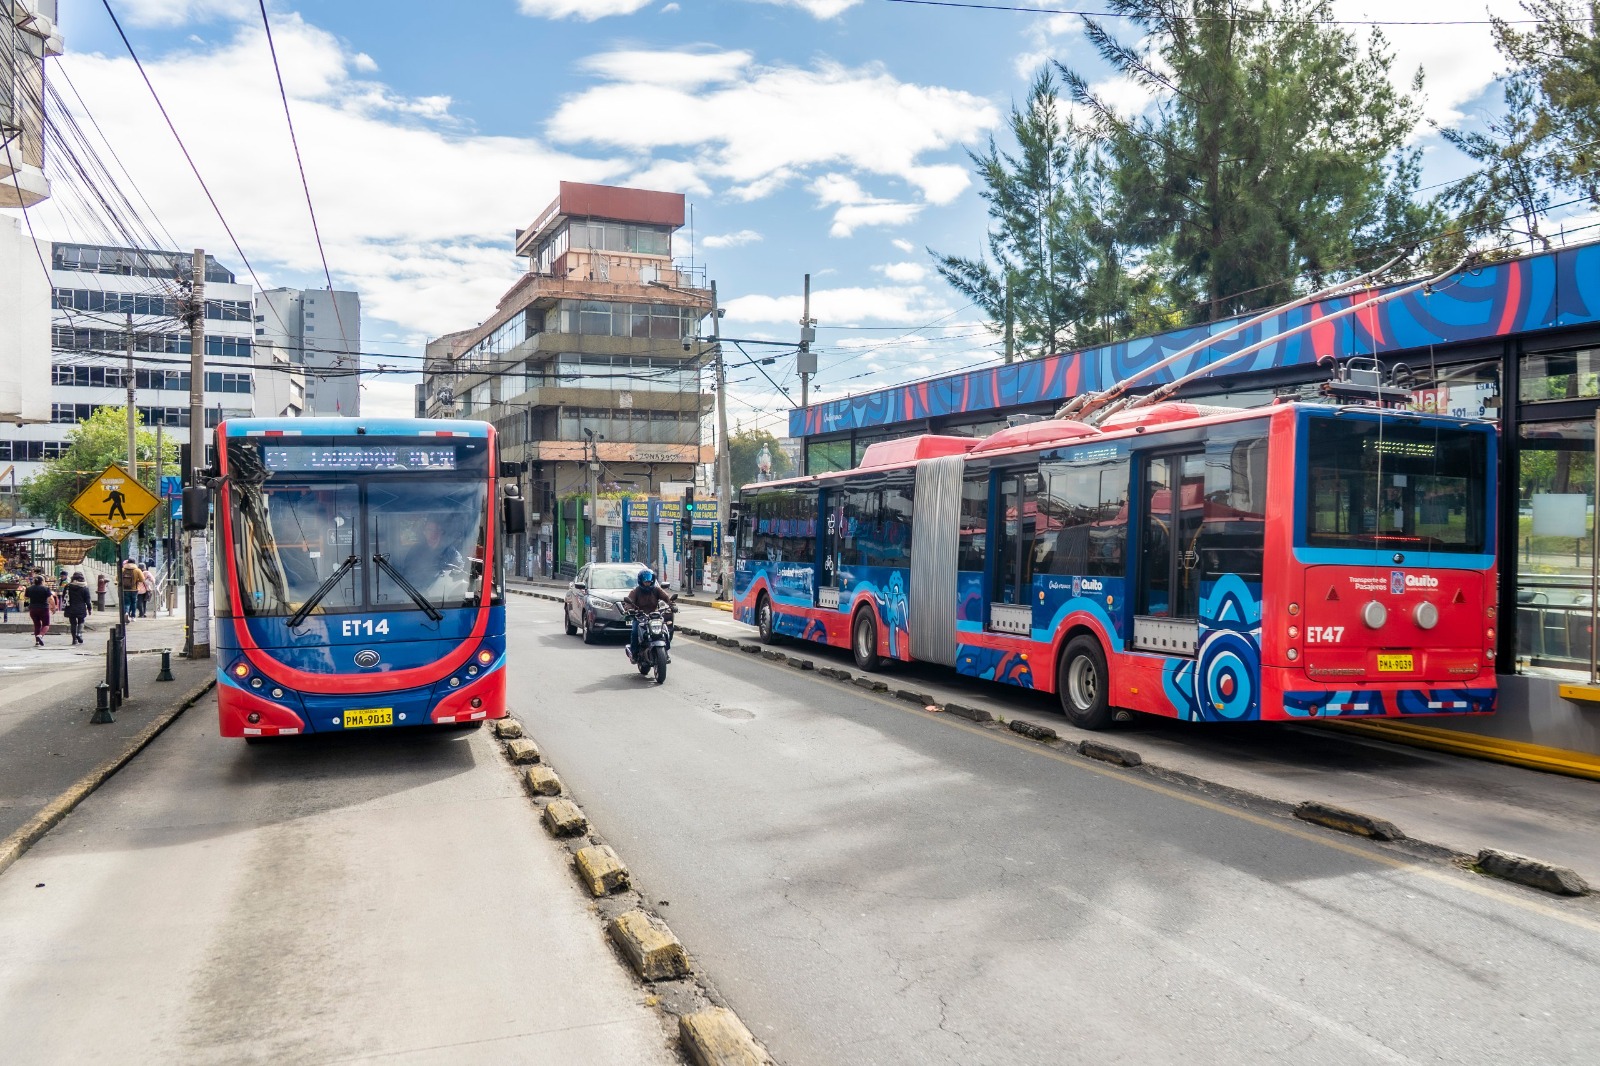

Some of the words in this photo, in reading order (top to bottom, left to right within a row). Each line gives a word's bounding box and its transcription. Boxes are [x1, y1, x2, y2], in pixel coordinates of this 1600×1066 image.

[1081, 579, 1102, 590] Quito
[1349, 576, 1378, 584] Transporte
[1406, 575, 1438, 587] Quito
[1355, 582, 1387, 591] Pasajeros
[342, 619, 389, 636] ET14
[1307, 626, 1344, 643] ET47
[1379, 659, 1412, 669] PMA-9039
[346, 713, 392, 726] PMA-9013
